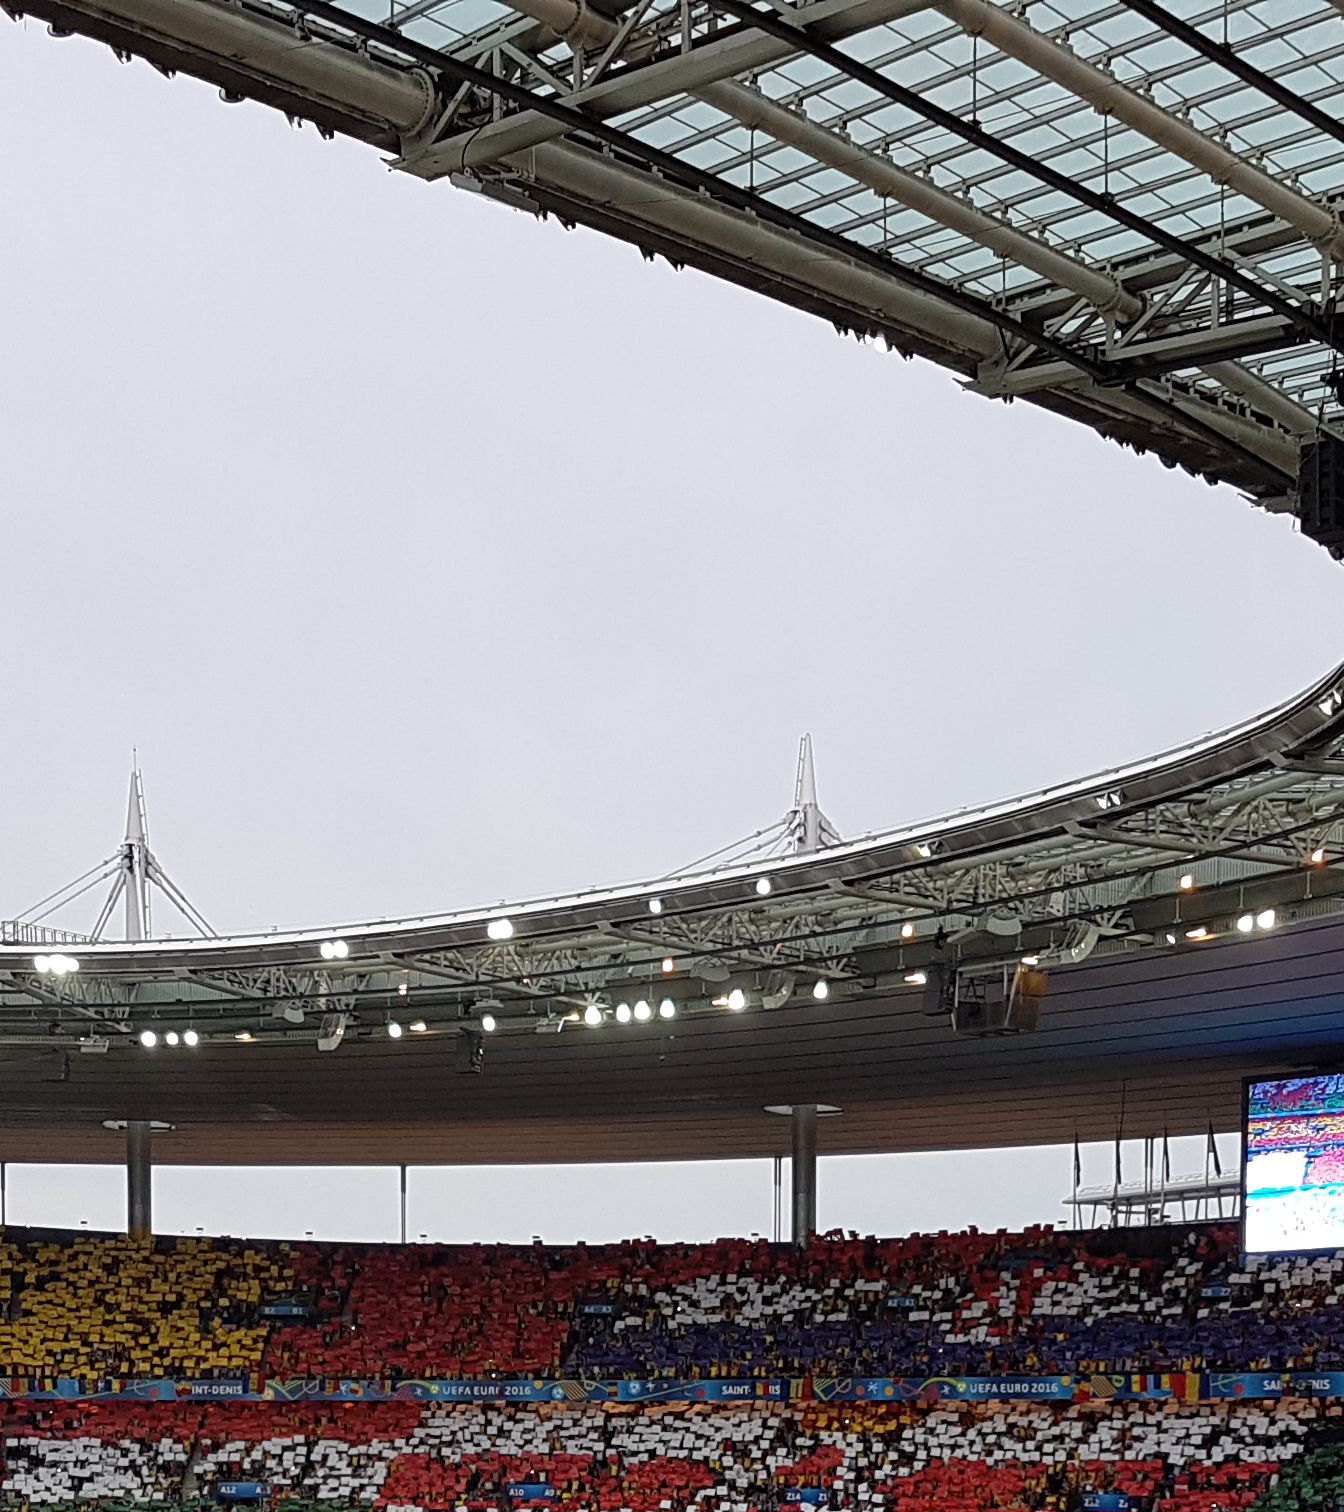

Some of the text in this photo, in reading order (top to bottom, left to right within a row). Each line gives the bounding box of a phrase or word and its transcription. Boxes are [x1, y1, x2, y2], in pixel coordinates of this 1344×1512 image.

[442, 1386, 472, 1397] UEFA
[504, 1386, 532, 1396] 2016
[970, 1382, 1057, 1394] UEFA EURO 2016
